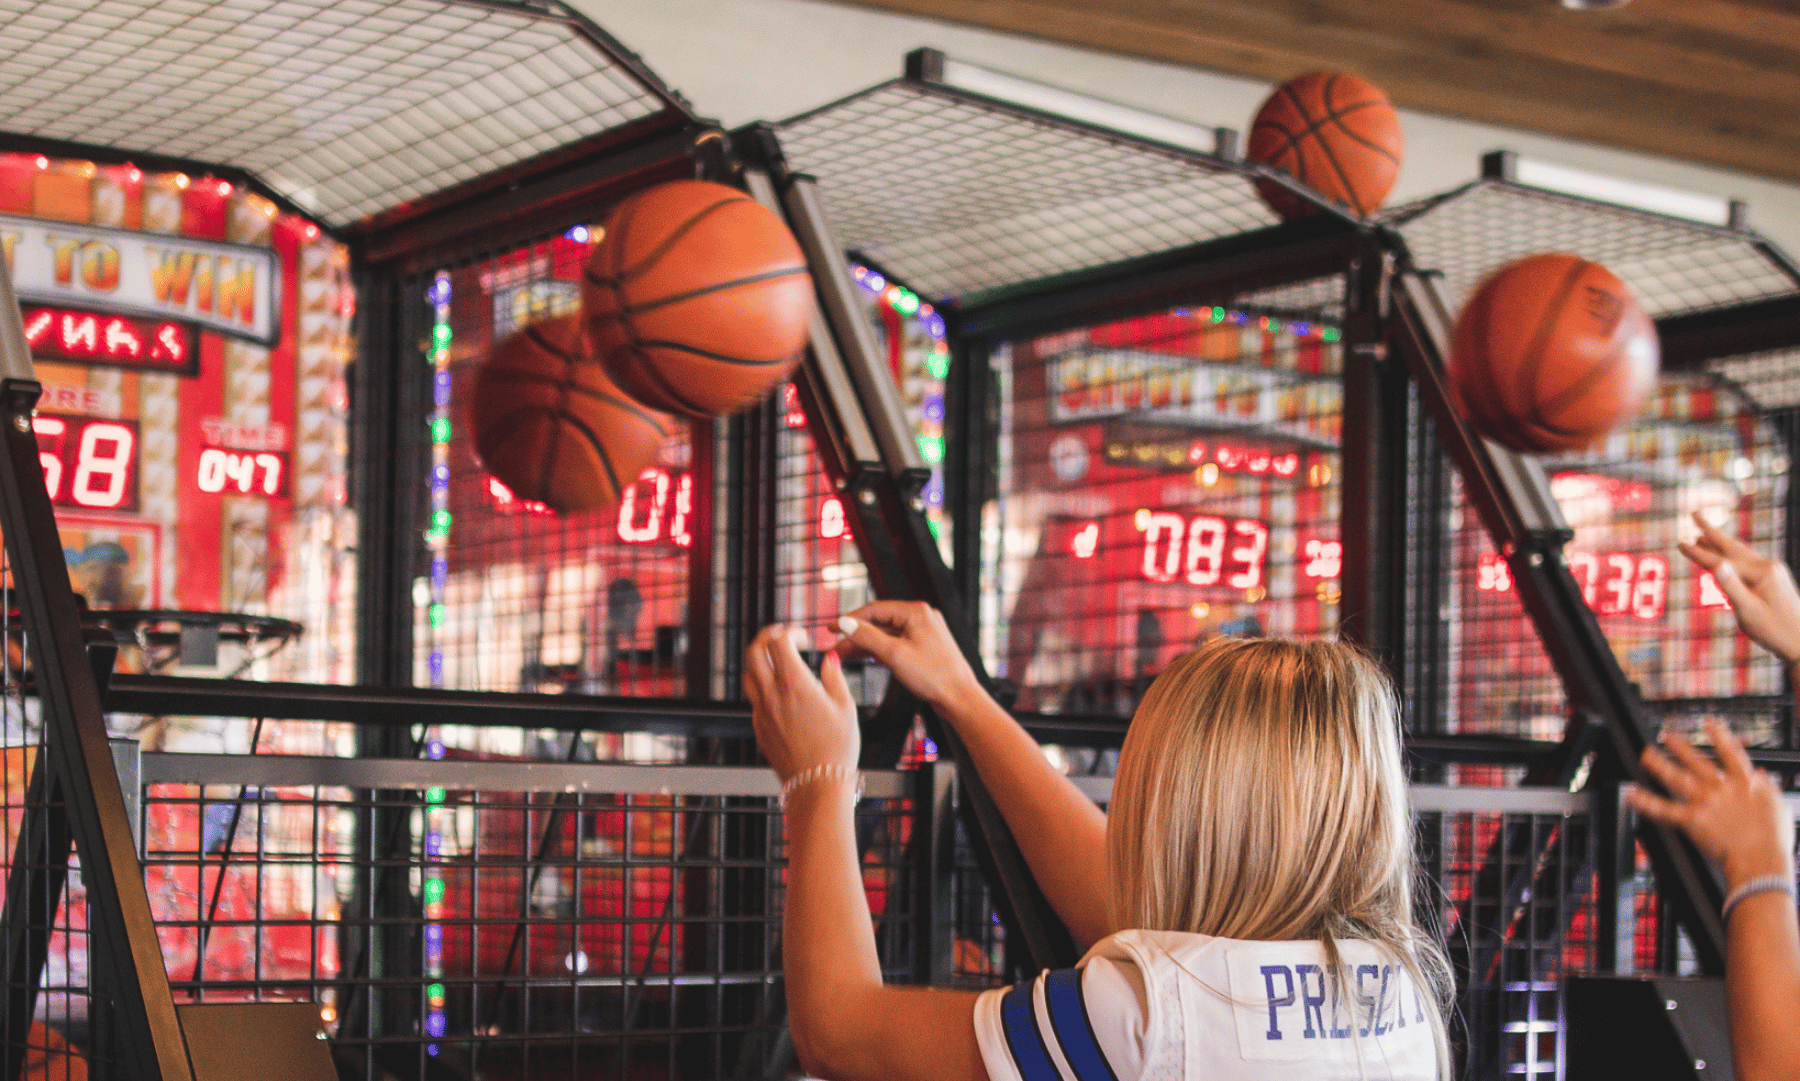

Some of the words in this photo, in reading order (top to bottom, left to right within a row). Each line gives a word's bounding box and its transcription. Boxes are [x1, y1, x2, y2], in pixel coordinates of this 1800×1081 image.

[46, 232, 120, 291] TO
[145, 246, 256, 324] WIN
[198, 448, 281, 496] 047
[1142, 511, 1269, 589] 083
